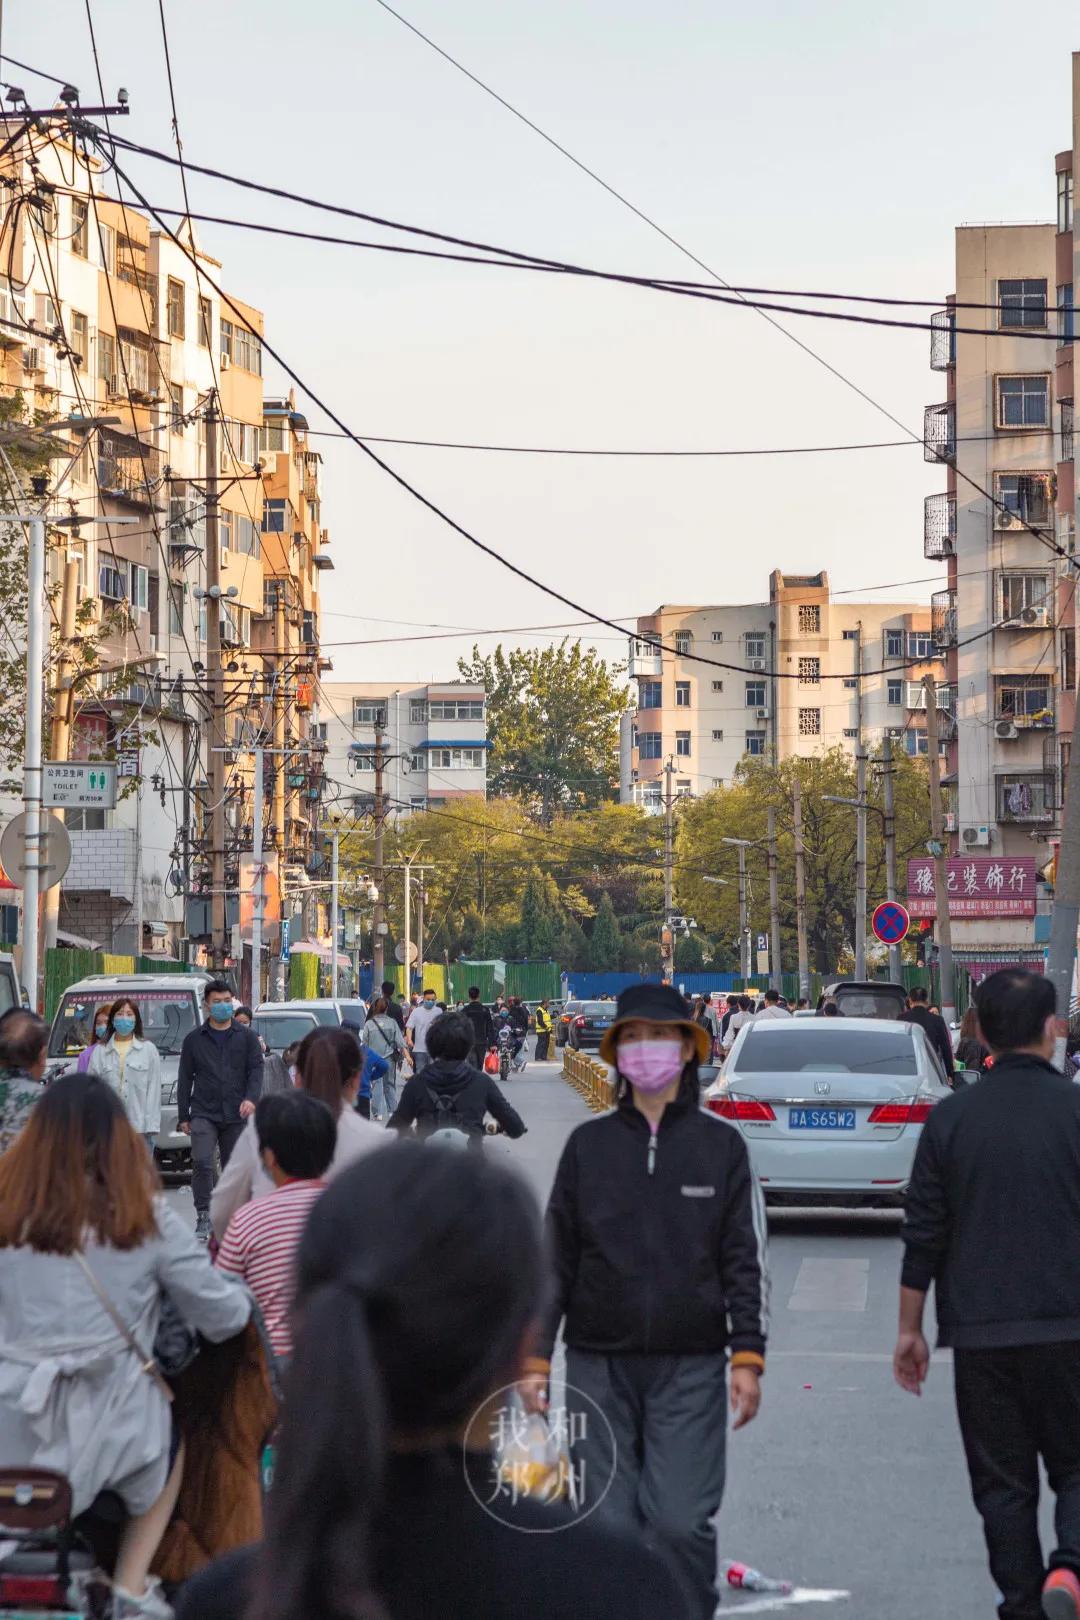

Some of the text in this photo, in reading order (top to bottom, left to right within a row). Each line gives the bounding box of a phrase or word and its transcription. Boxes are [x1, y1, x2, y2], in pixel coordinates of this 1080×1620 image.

[47, 768, 84, 778] 公共卫生间
